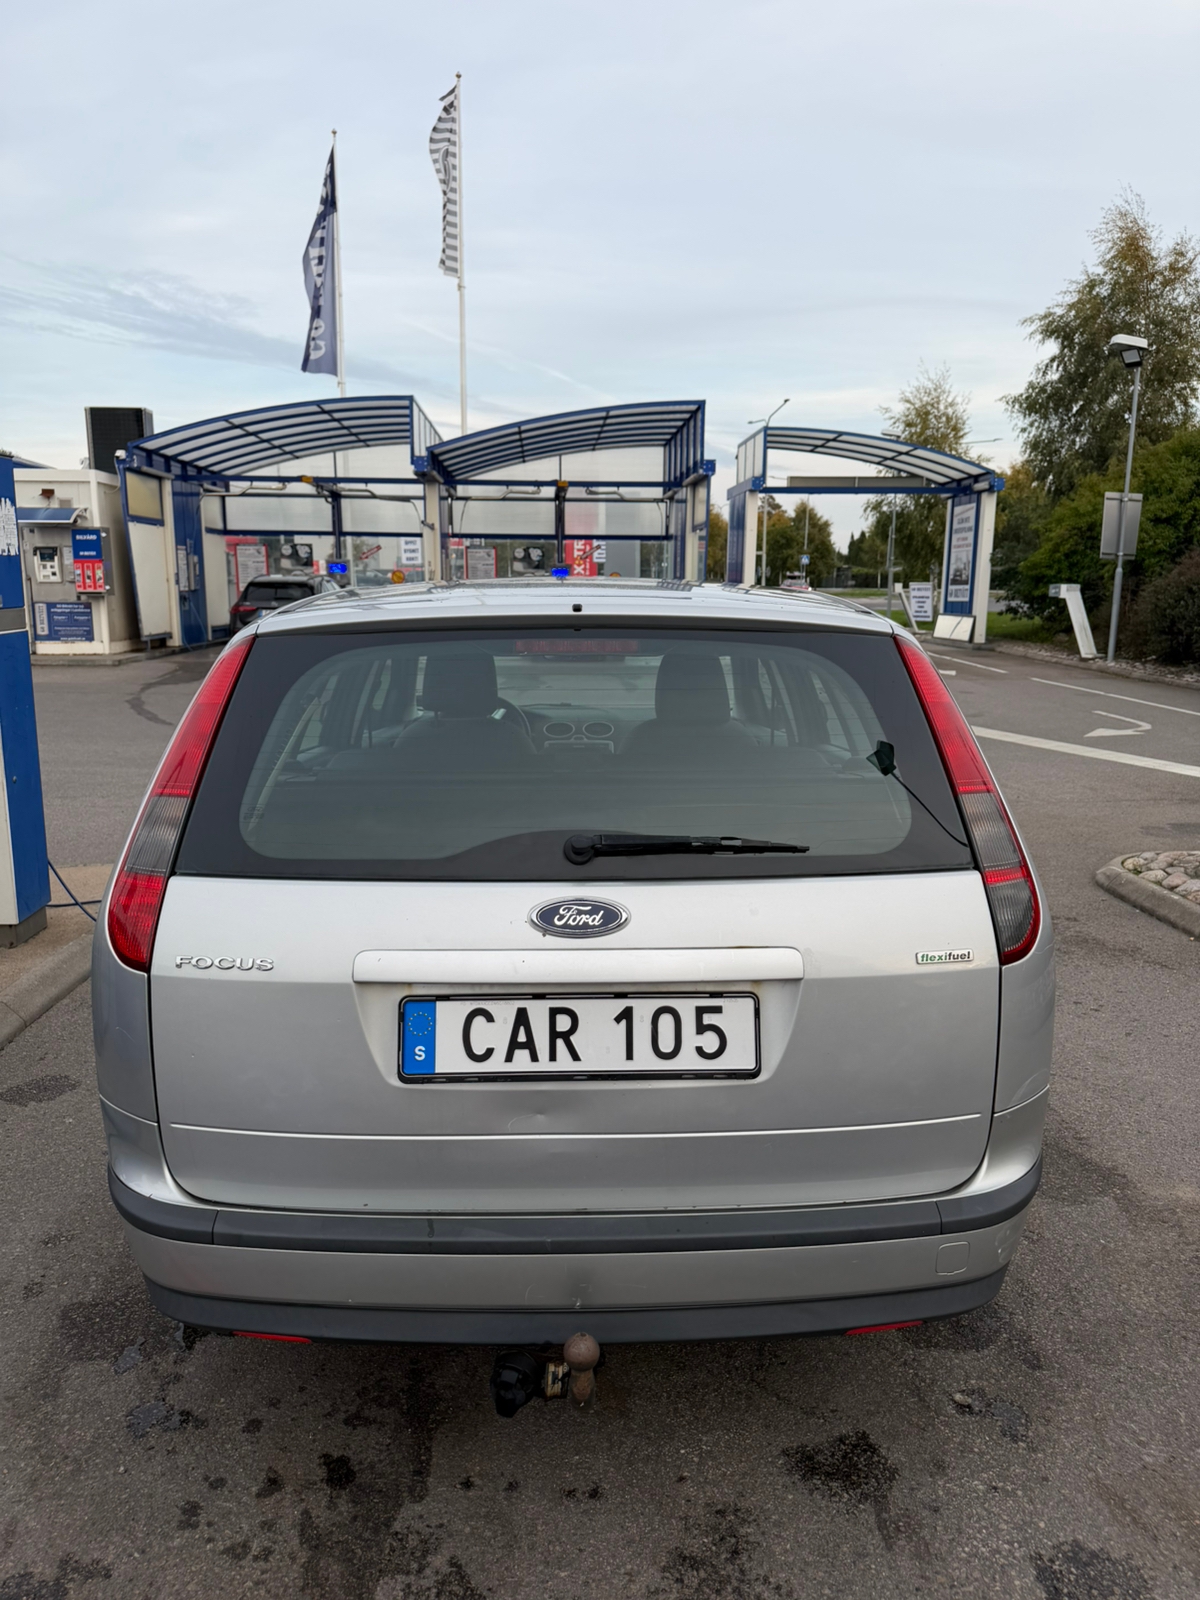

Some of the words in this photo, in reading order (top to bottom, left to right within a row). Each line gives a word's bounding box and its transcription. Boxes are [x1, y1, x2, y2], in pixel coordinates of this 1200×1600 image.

[553, 904, 605, 926] Ford
[175, 955, 275, 972] FOCUS
[920, 950, 971, 963] flexifuel
[461, 1005, 582, 1063] CAR
[613, 1005, 728, 1061] 105
[414, 1045, 426, 1061] S
